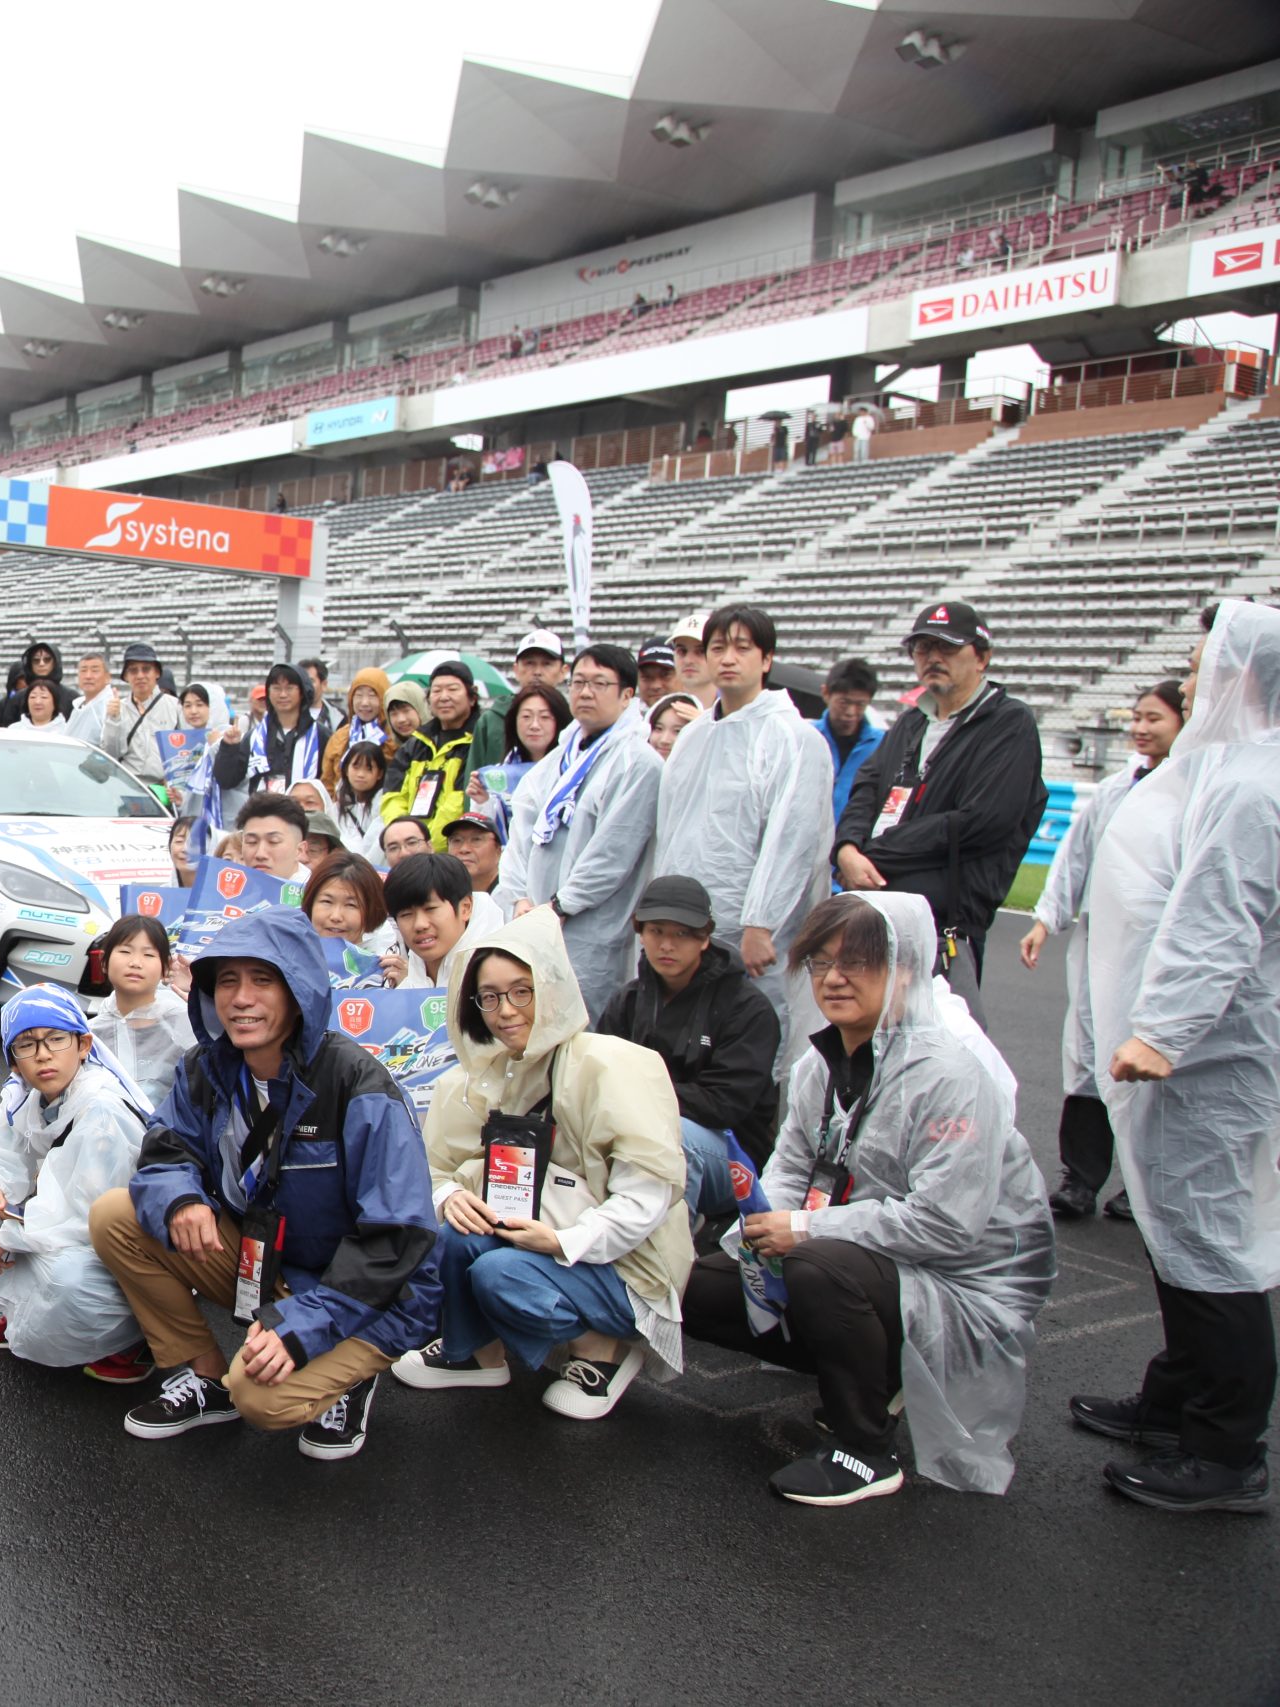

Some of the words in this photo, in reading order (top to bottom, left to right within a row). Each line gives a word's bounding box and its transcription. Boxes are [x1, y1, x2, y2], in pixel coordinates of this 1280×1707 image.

[961, 267, 1109, 318] DAIHATSU
[125, 516, 230, 553] systena
[224, 872, 240, 884] 97
[143, 896, 156, 906] 97
[346, 1002, 366, 1016] 97
[430, 1001, 447, 1014] 98
[384, 1043, 426, 1057] TEC
[523, 1171, 532, 1181] 4
[730, 1168, 748, 1185] 97
[490, 1183, 532, 1193] CREDENTIAL
[831, 1449, 875, 1484] PUMA
